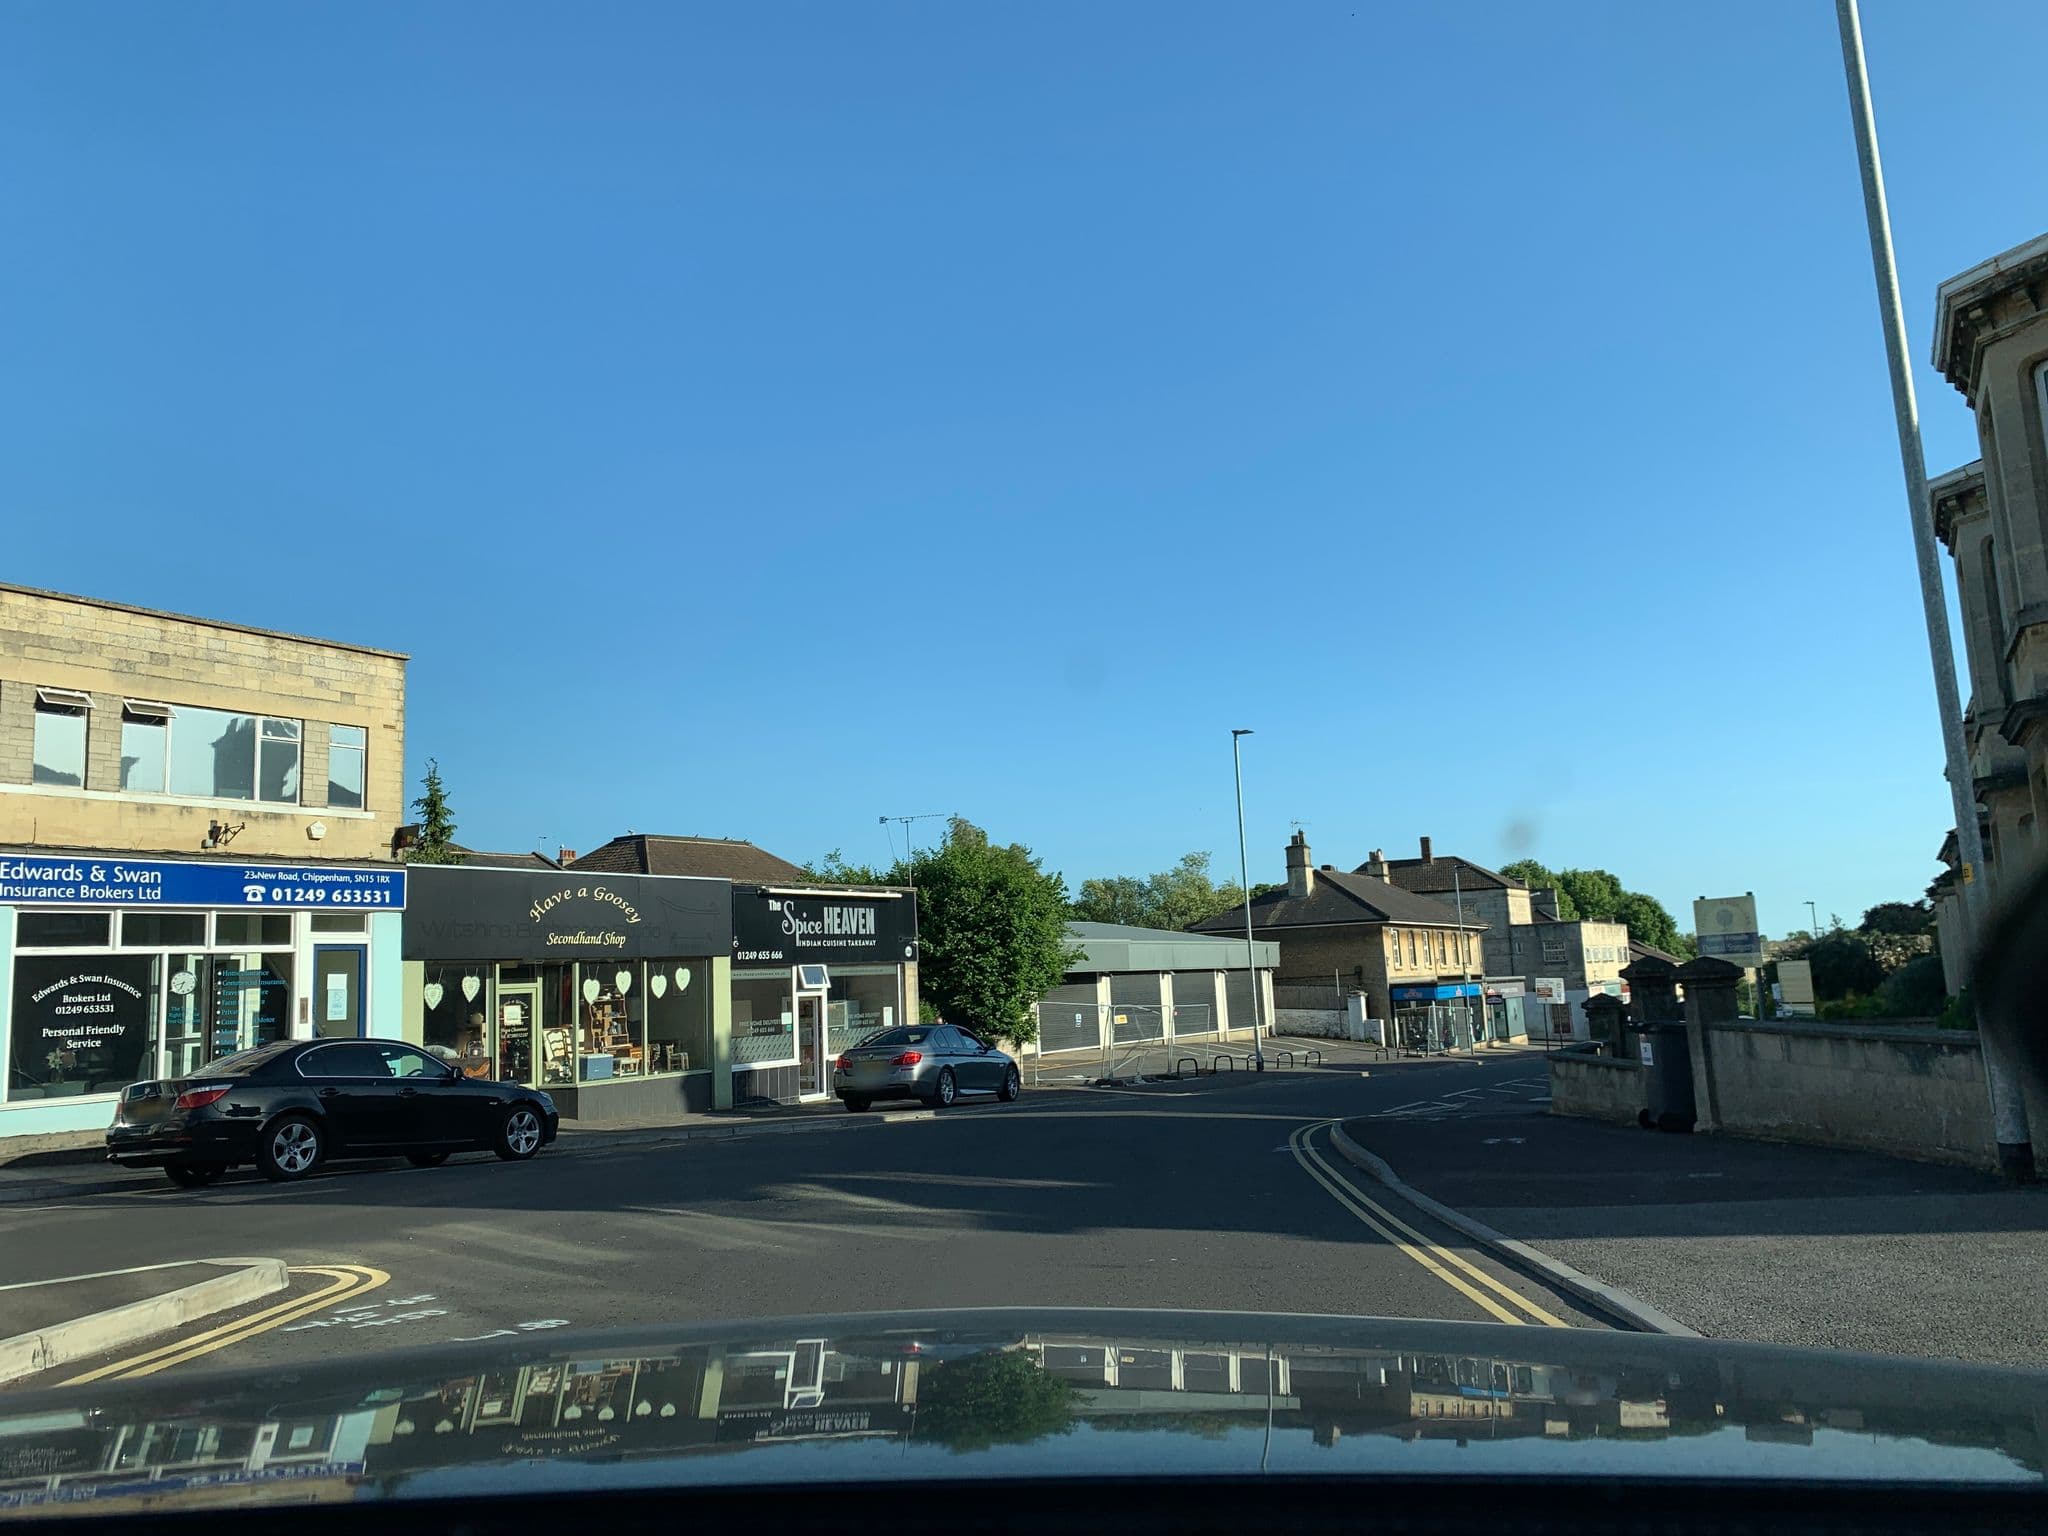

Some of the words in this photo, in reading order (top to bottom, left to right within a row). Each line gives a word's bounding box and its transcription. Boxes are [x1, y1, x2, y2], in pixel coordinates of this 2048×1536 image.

[0, 861, 83, 882] Edwards
[90, 865, 106, 882] &
[113, 866, 161, 884] Swan
[258, 871, 276, 880] New
[278, 871, 300, 882] Road,
[302, 872, 352, 884] Chippenham,
[354, 874, 374, 883] SN15
[376, 875, 391, 884] 1RX
[0, 883, 75, 898] Insurance
[80, 885, 134, 899] Brokers
[139, 886, 161, 900] Ltd
[272, 888, 326, 902] 01249
[332, 889, 391, 903] 653531
[529, 889, 573, 923] Have
[577, 887, 588, 898] a
[594, 886, 642, 924] Goosey
[768, 899, 782, 911] The
[781, 900, 823, 946] Spice
[823, 907, 876, 935] HEAVEN
[546, 931, 602, 945] Secondhand
[603, 932, 626, 948] Shop
[848, 939, 877, 947] TAKEAWAY
[737, 951, 757, 960] 01249
[758, 951, 770, 960] 655
[771, 950, 783, 960] 666
[31, 979, 69, 1003] Edwards
[70, 976, 79, 985] &
[79, 974, 103, 983] Swan
[103, 975, 142, 999] Insurance
[62, 994, 95, 1003] Brokers
[96, 993, 111, 1002] Ltd
[55, 1005, 82, 1015] 01249
[83, 1004, 114, 1014] 653531
[42, 1026, 84, 1037] Personal
[86, 1024, 125, 1035] Friendly
[66, 1039, 102, 1049] Service
